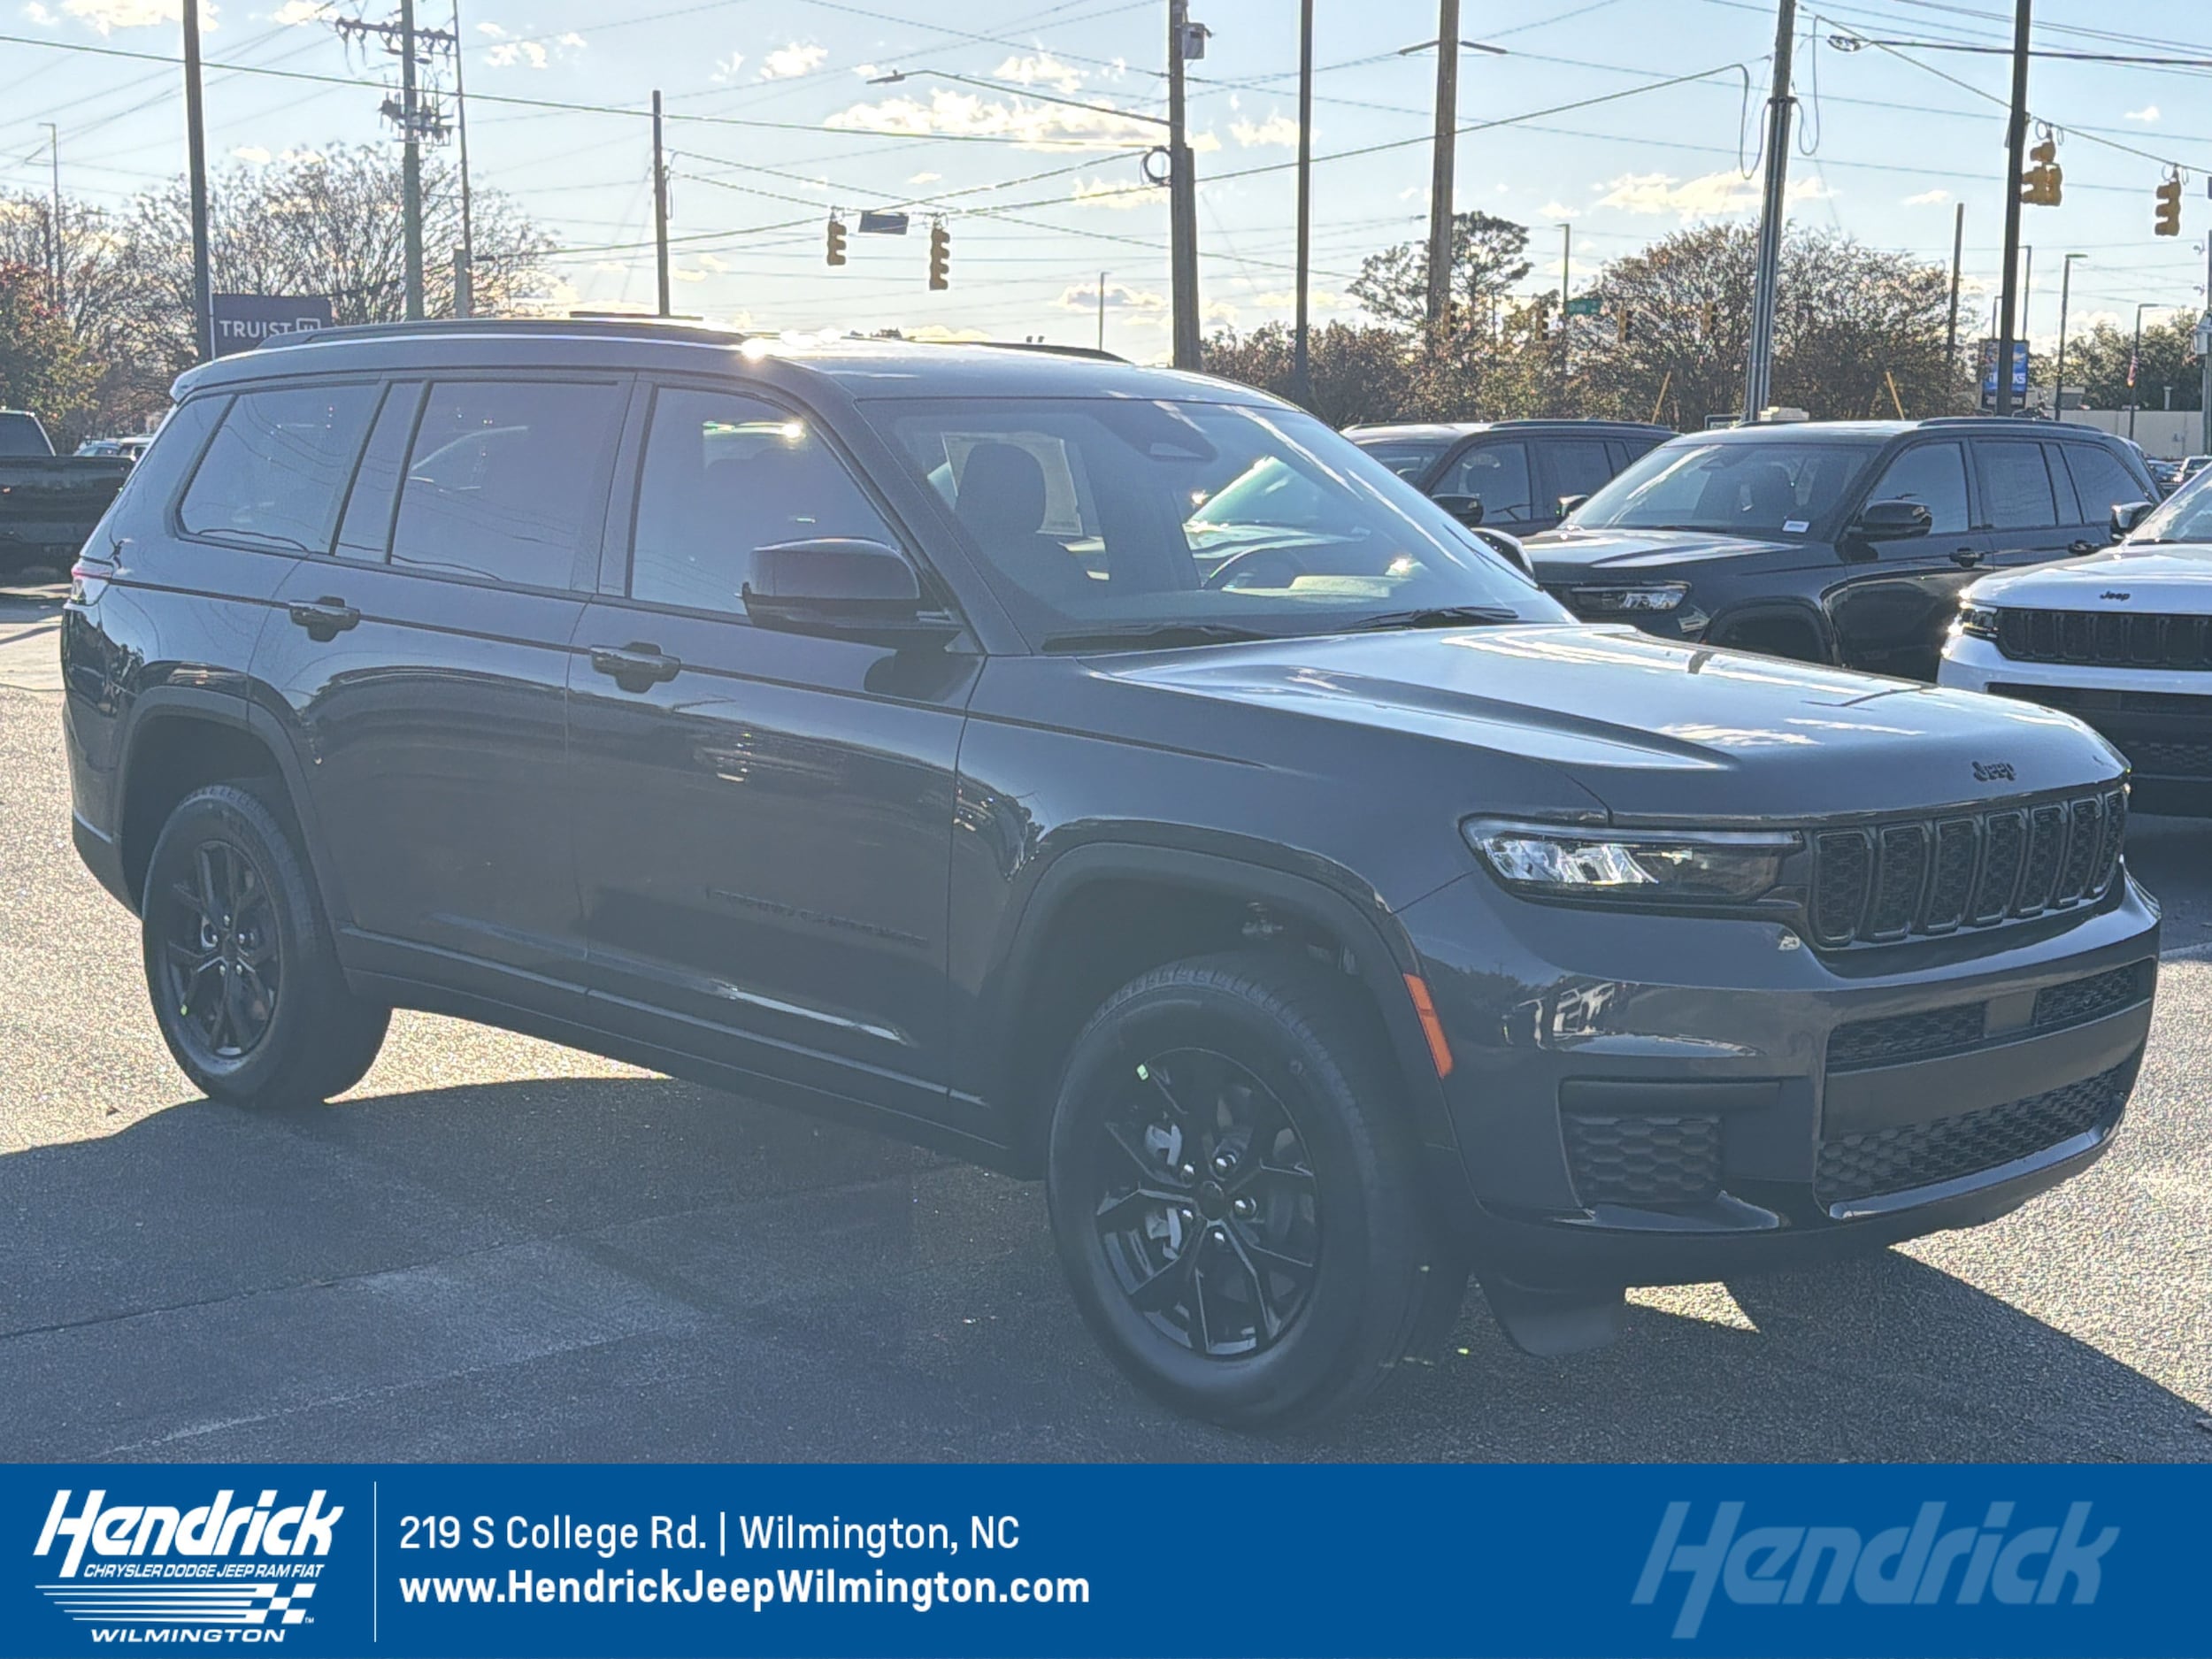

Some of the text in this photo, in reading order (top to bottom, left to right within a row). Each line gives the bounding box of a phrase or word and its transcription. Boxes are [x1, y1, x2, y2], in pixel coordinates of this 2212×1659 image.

[219, 319, 292, 338] TRUIST
[2099, 589, 2131, 603] Jeep
[1971, 760, 2016, 782] Jeep
